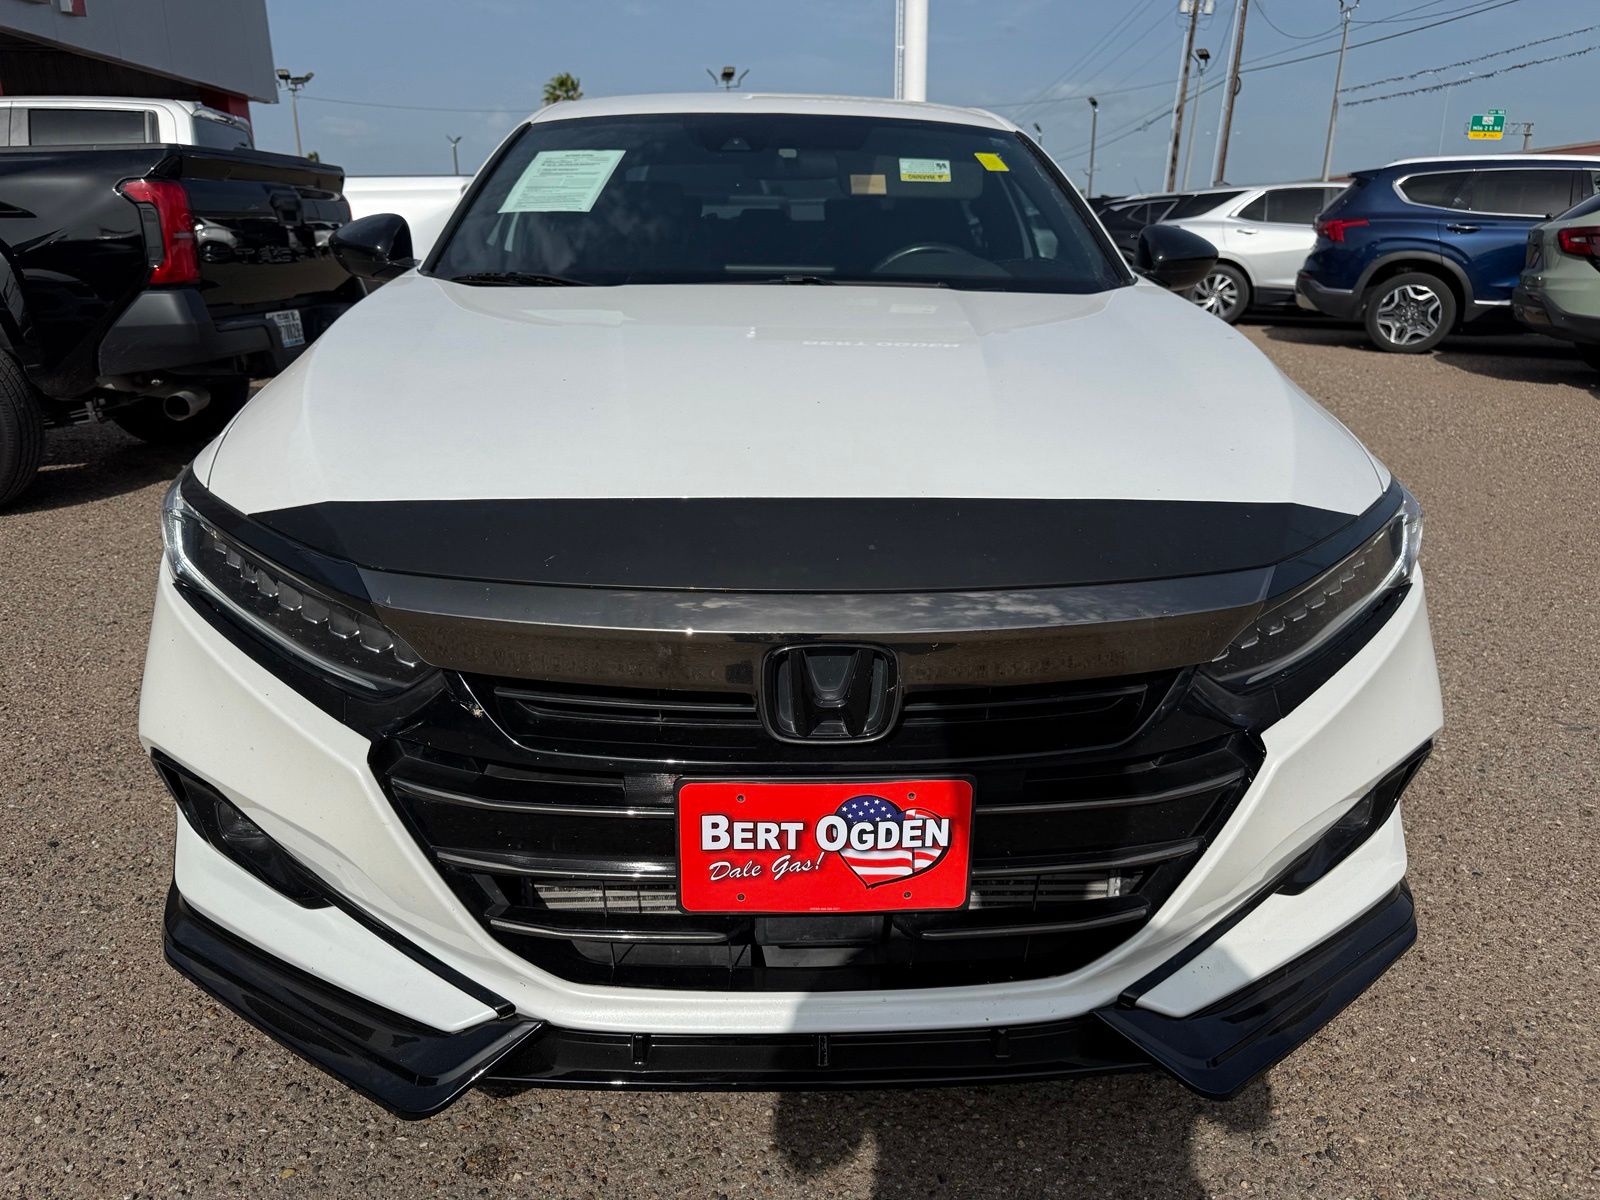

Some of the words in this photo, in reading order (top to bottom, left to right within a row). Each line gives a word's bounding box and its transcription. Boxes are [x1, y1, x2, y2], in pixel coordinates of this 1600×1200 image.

[701, 815, 804, 851] BERT
[816, 815, 950, 851] OGDEN
[709, 860, 761, 881] Dale
[771, 852, 825, 881] Gas!
